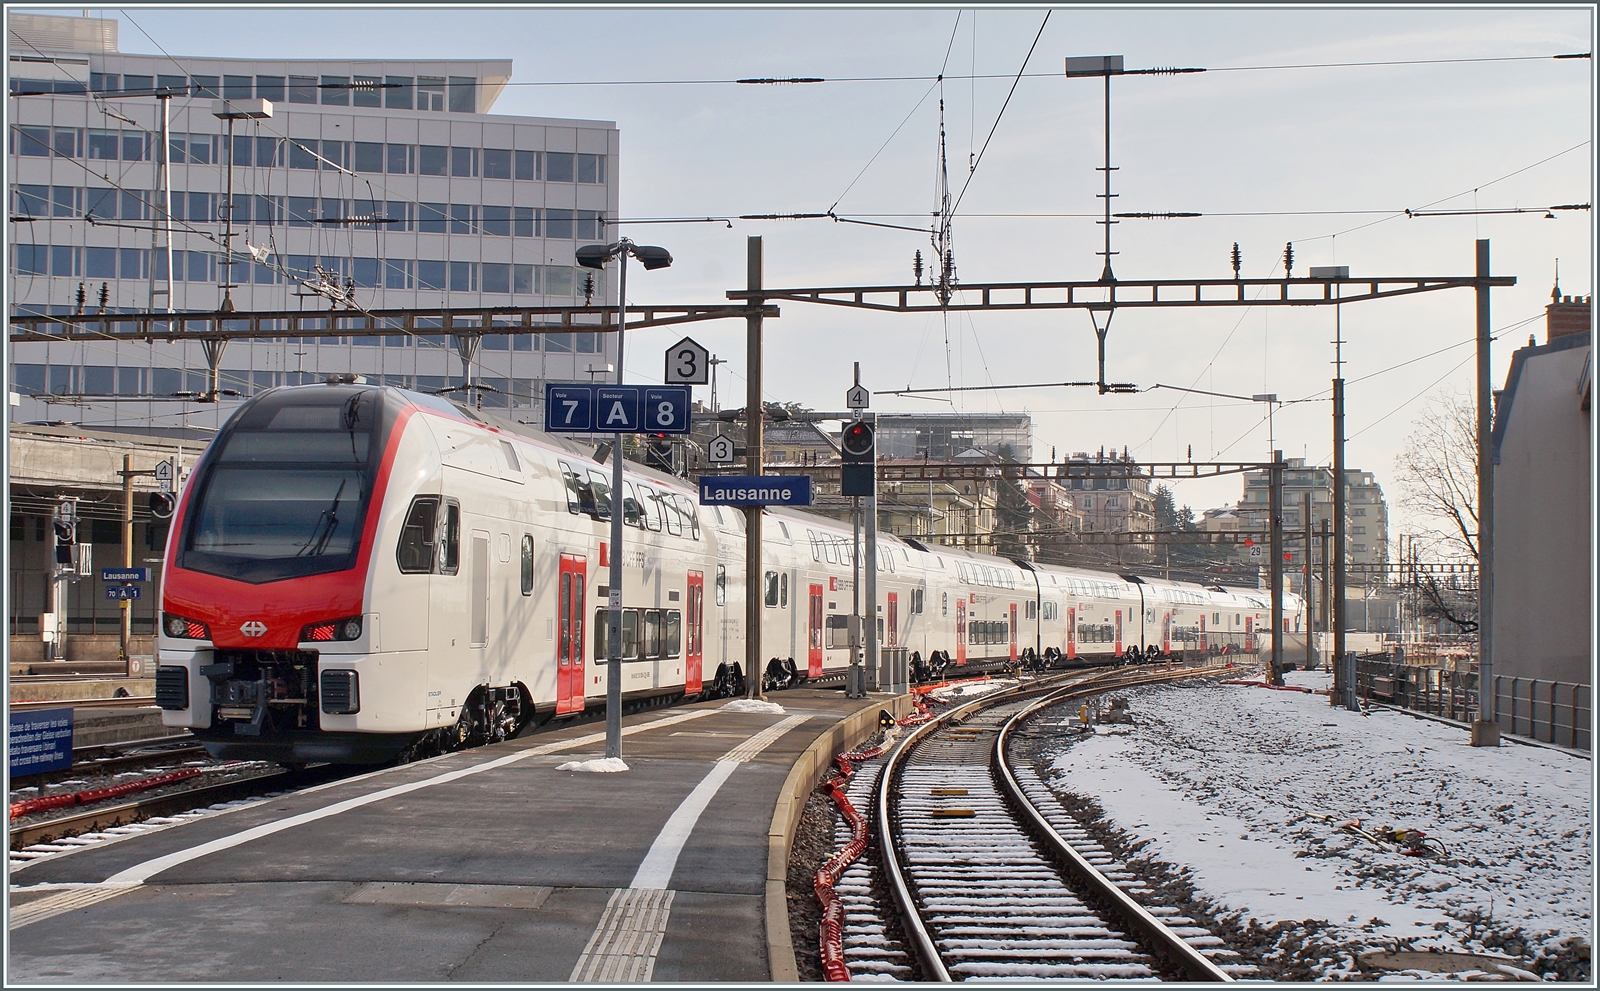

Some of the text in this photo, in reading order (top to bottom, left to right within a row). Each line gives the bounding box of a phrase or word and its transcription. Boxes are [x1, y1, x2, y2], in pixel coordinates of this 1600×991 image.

[677, 349, 697, 378] 3
[852, 390, 863, 405] 4
[562, 400, 674, 426] 7 A 8
[715, 441, 727, 459] 3
[160, 465, 168, 478] 4
[704, 485, 792, 501] Lausanne
[1251, 547, 1261, 556] 29
[103, 572, 140, 580] Lausanne
[24, 722, 30, 731] de
[31, 721, 50, 730] traverser
[57, 718, 68, 727] voies
[19, 756, 31, 766] cross
[54, 751, 63, 760] lines
